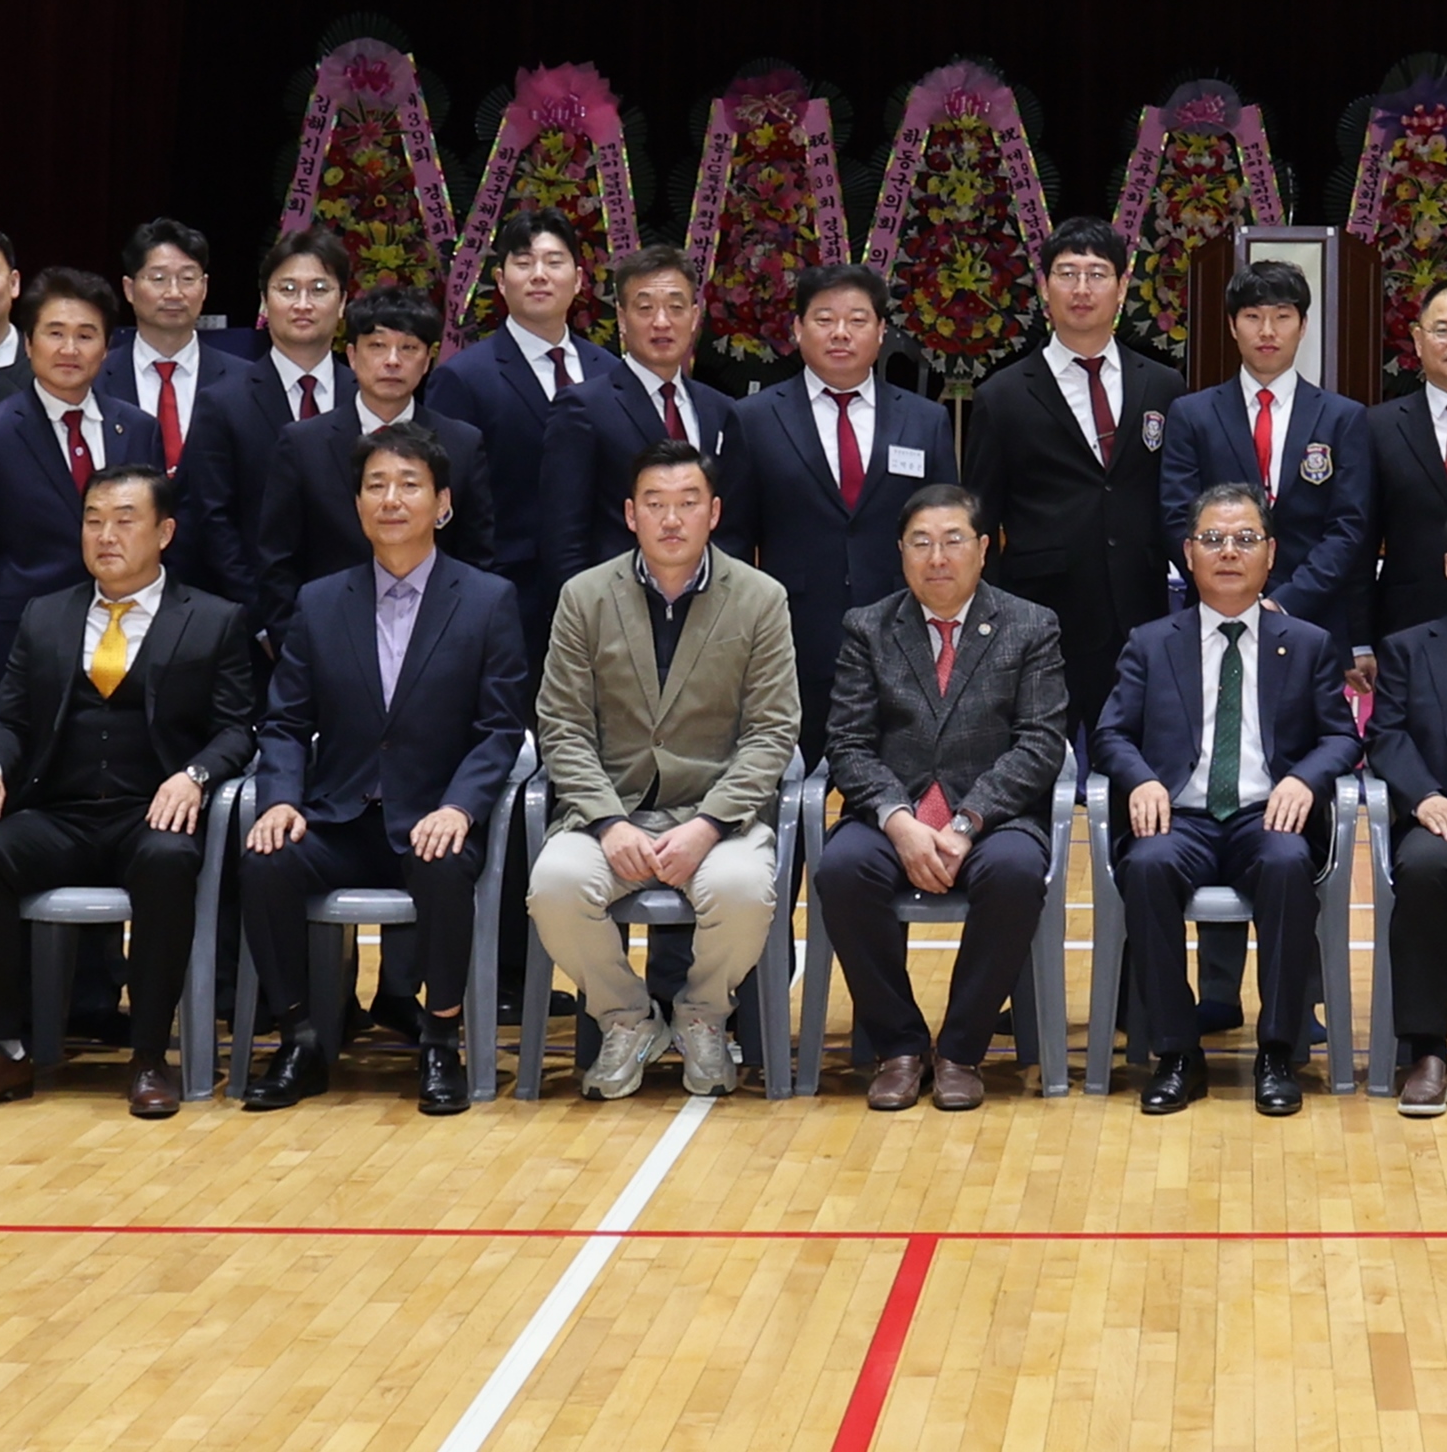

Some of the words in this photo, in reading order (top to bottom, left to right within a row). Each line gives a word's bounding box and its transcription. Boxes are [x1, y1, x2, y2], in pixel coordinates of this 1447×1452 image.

[423, 183, 452, 248] 경남회
[466, 147, 518, 254] 하동군체육회
[877, 128, 922, 234] 하동군의회
[823, 216, 843, 266] 경남회
